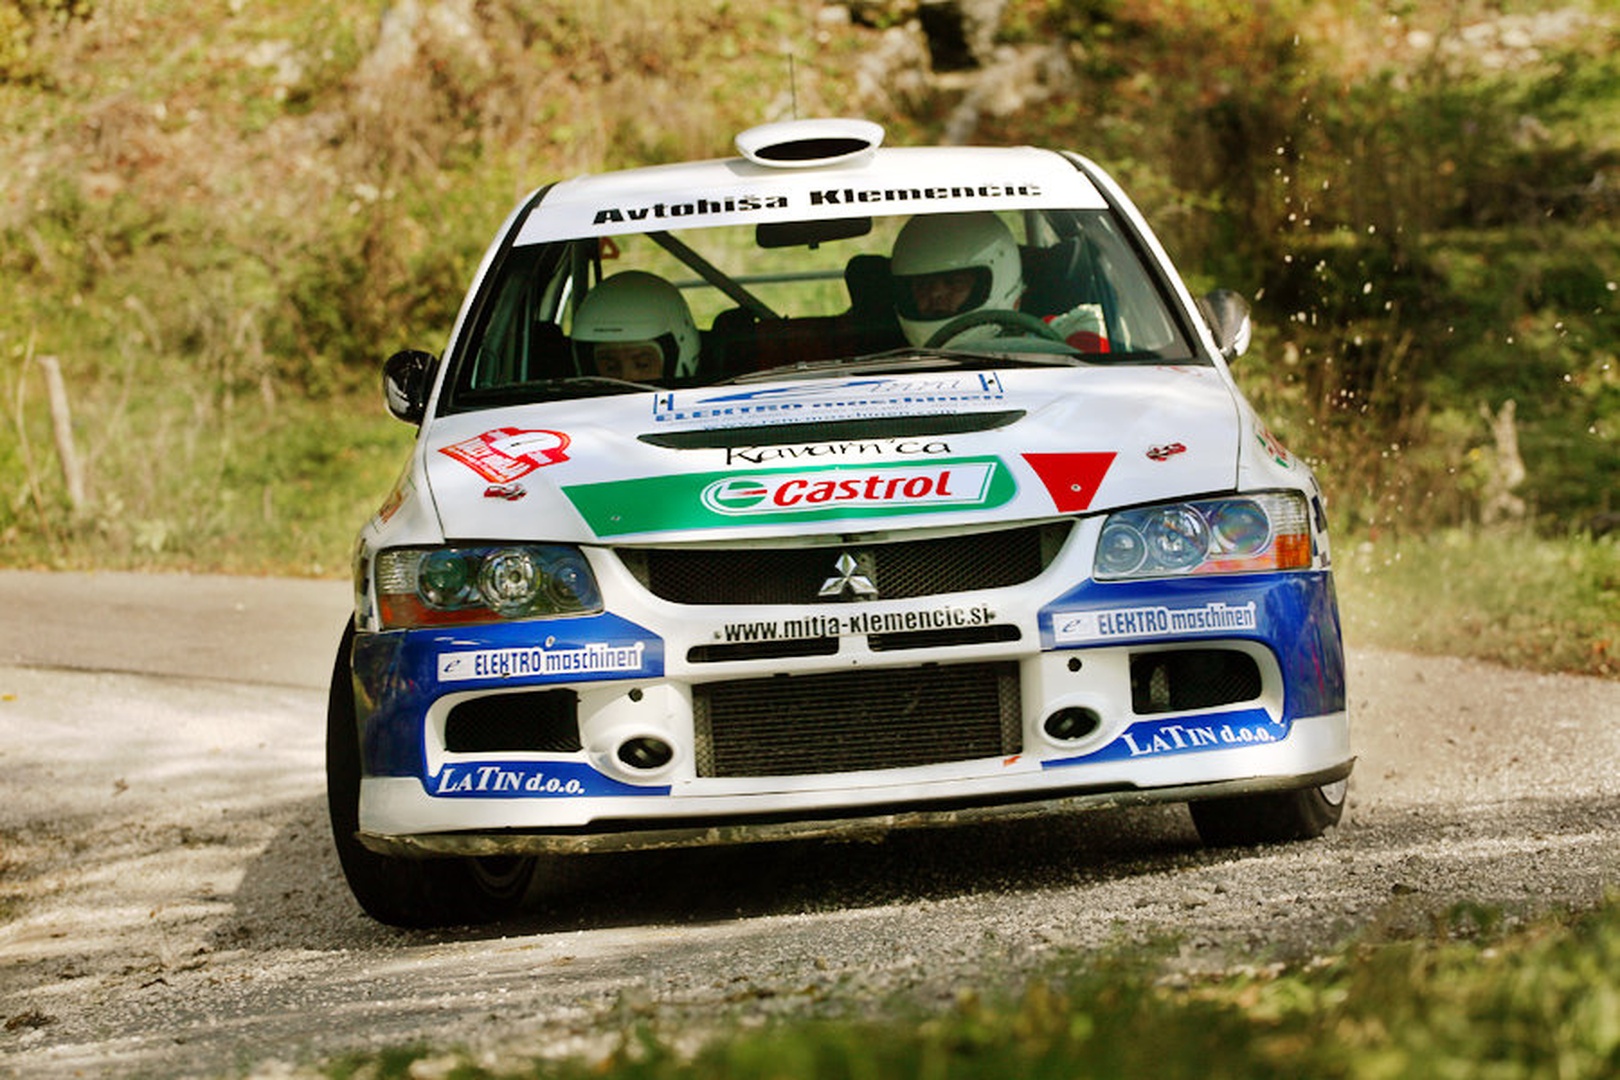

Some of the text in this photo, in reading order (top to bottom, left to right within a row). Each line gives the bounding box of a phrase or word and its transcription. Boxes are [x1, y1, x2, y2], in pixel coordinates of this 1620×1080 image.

[593, 194, 789, 225] Avtohiša
[773, 471, 951, 507] Castrol
[1099, 609, 1168, 635] ELEKTRO
[1171, 604, 1251, 631] maschinen
[474, 650, 541, 676] ELEKTRO
[546, 646, 639, 673] maschinen
[1220, 724, 1276, 744] d.o.o.
[525, 774, 585, 795] d.o.o.
